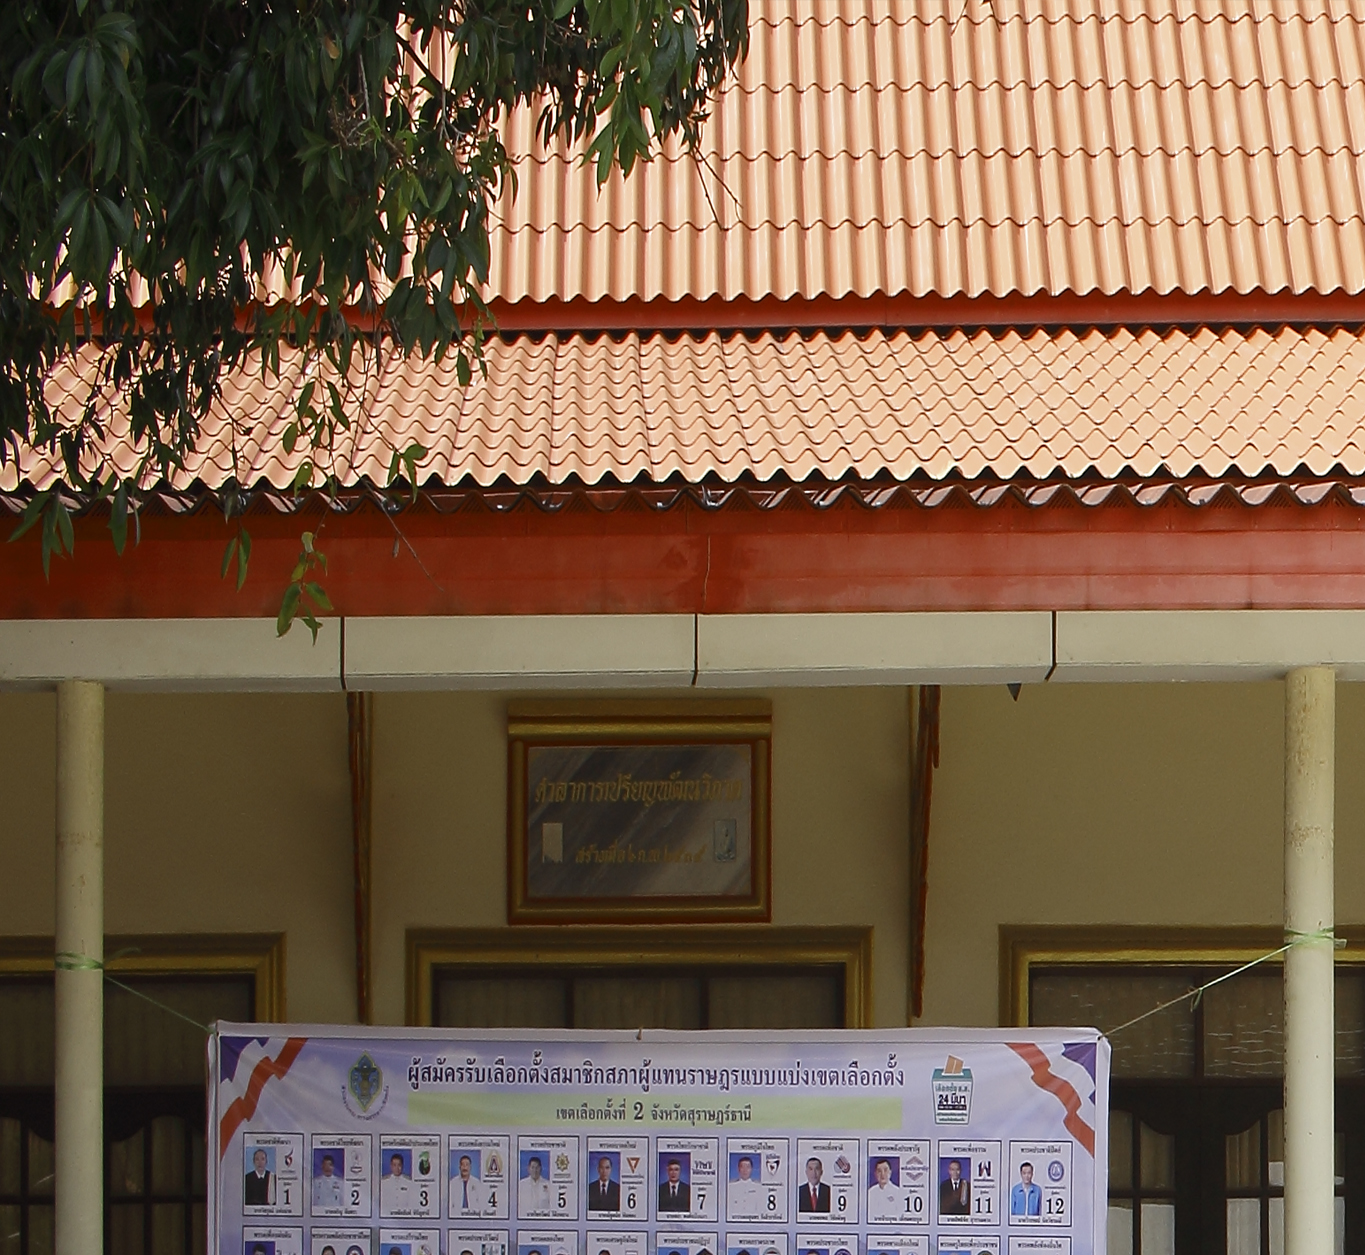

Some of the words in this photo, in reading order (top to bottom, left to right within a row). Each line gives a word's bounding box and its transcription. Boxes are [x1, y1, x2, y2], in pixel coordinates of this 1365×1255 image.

[408, 1050, 904, 1092] ผู้สมัครรับเลือกตั้งสมาชิกสภาผู้แทนราษฎรแบบแบ่งเขตเลือกตั้ง
[938, 1094, 948, 1104] 24
[556, 1098, 627, 1121] เขตเลือกตั้งที่
[633, 1102, 645, 1121] 2
[651, 1103, 752, 1126] จังหวัดสุราษฎร์ธานี
[283, 1190, 290, 1205] 1
[351, 1190, 360, 1205] 2
[419, 1190, 429, 1206] 3
[488, 1192, 497, 1207] 4
[558, 1192, 566, 1208] 5
[627, 1193, 636, 1209] 6
[697, 1194, 706, 1209] 7
[767, 1195, 776, 1210] 8
[837, 1195, 847, 1211] 9
[904, 1196, 922, 1212] 10
[975, 1197, 992, 1213] 11
[1046, 1198, 1064, 1214] 12
